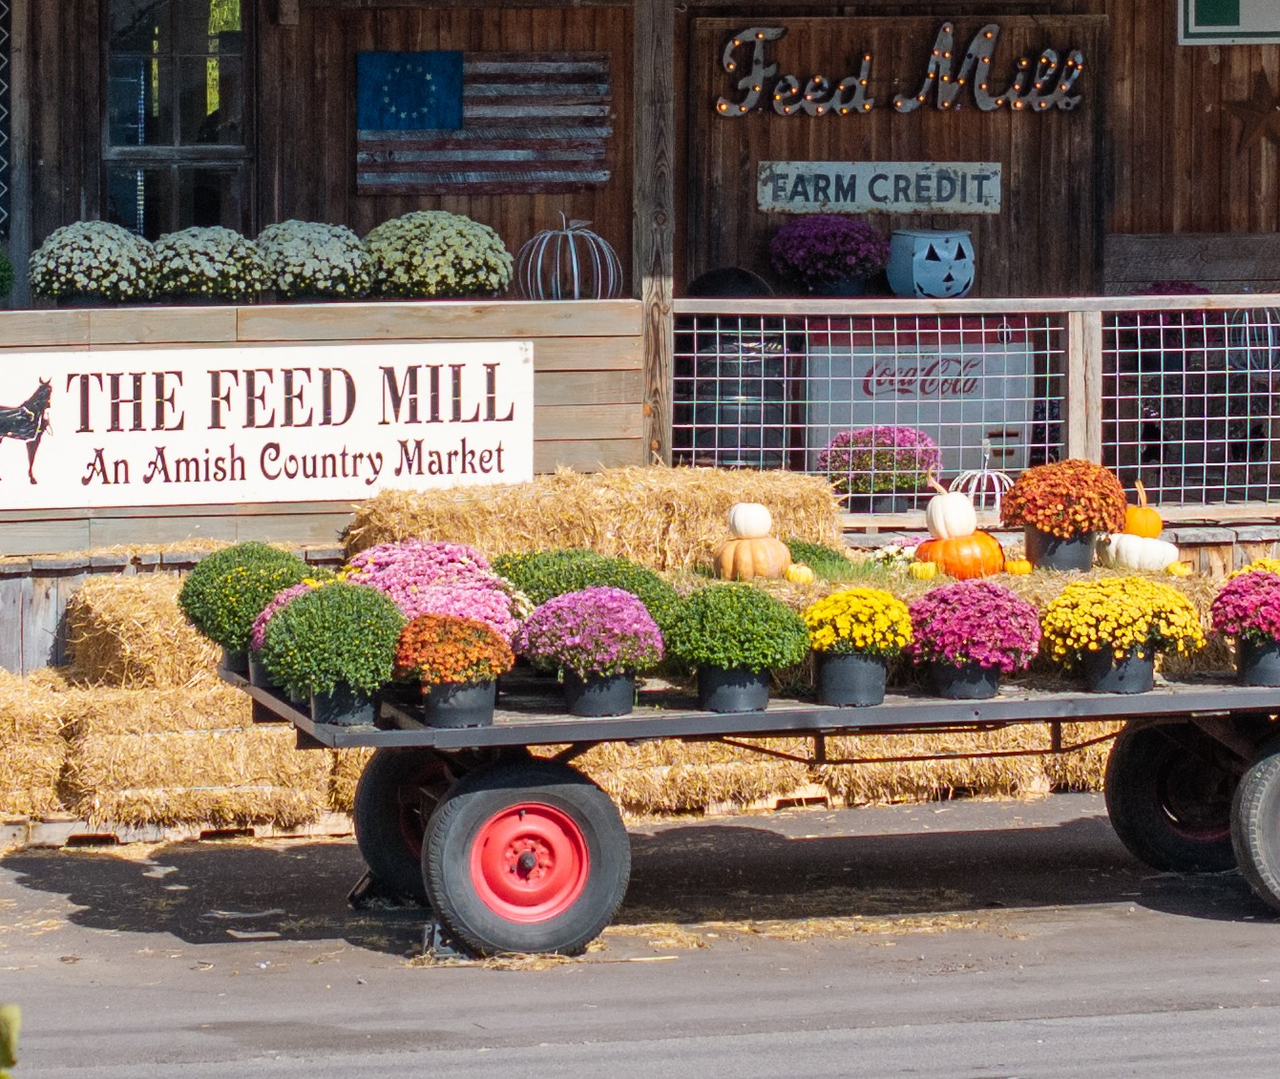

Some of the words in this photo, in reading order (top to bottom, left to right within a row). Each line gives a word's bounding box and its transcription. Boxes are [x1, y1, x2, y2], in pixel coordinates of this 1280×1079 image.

[716, 26, 874, 117] Feed
[893, 22, 1084, 113] Mill
[770, 172, 857, 204] FARM
[867, 173, 991, 204] CREDIT
[65, 370, 185, 434] THE
[206, 367, 357, 430] FEED
[377, 362, 515, 426] MILL
[81, 447, 131, 486] An
[142, 442, 247, 485] Amish
[259, 441, 383, 486] Country
[394, 436, 505, 478] Market
